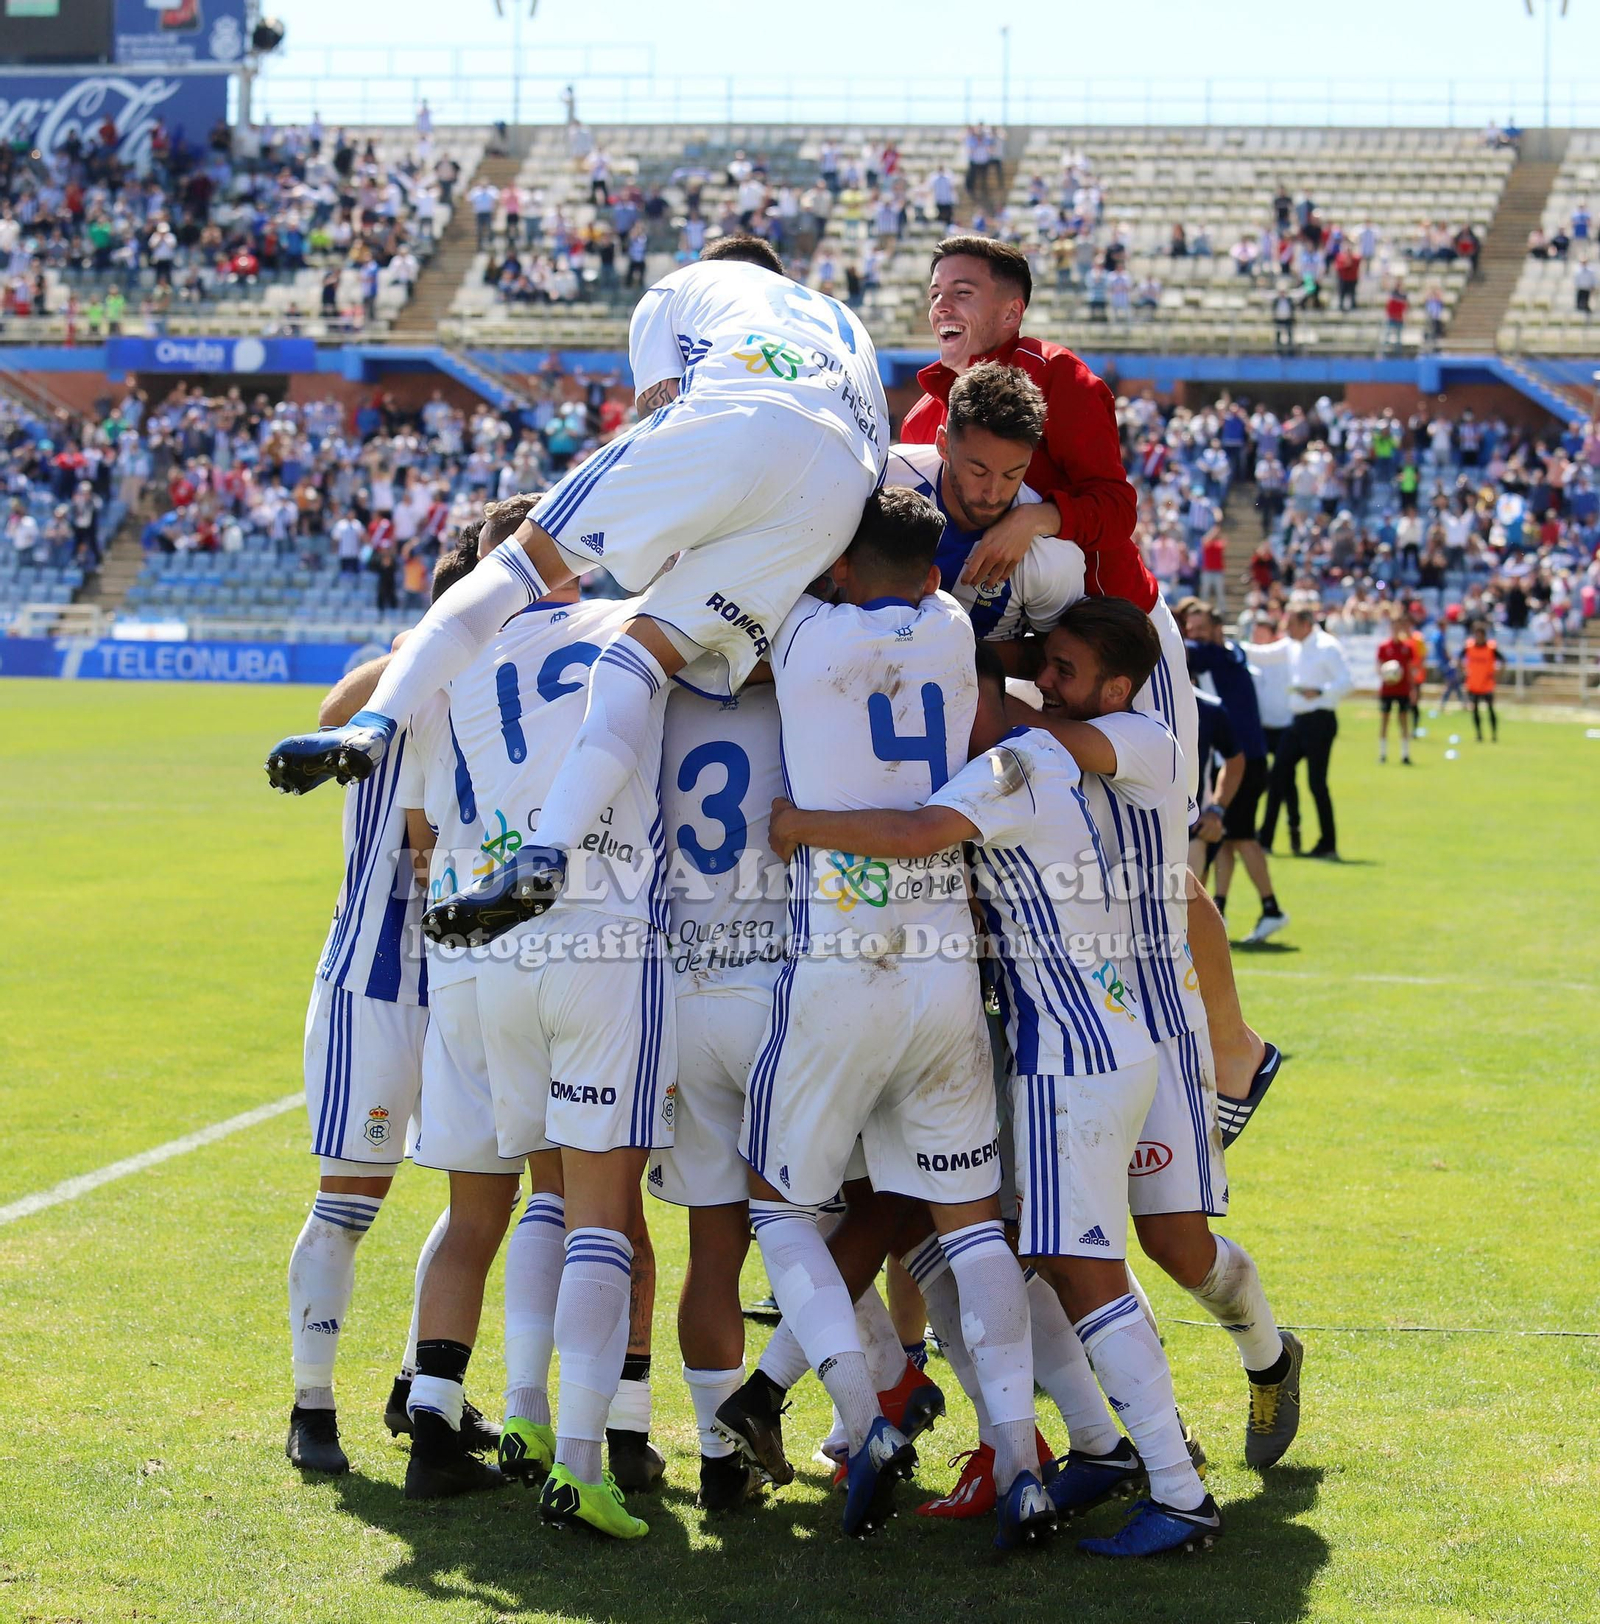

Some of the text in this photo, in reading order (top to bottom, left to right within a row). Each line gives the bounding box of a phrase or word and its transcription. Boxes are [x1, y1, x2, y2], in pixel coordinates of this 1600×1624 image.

[706, 592, 770, 658] ROMER
[100, 646, 289, 681] TELEONUBA
[867, 682, 949, 795] 4
[677, 740, 751, 875] 3
[680, 919, 774, 947] Que sea
[675, 948, 701, 974] de
[550, 1077, 617, 1106] OMERO
[1078, 1237, 1111, 1247] adidas
